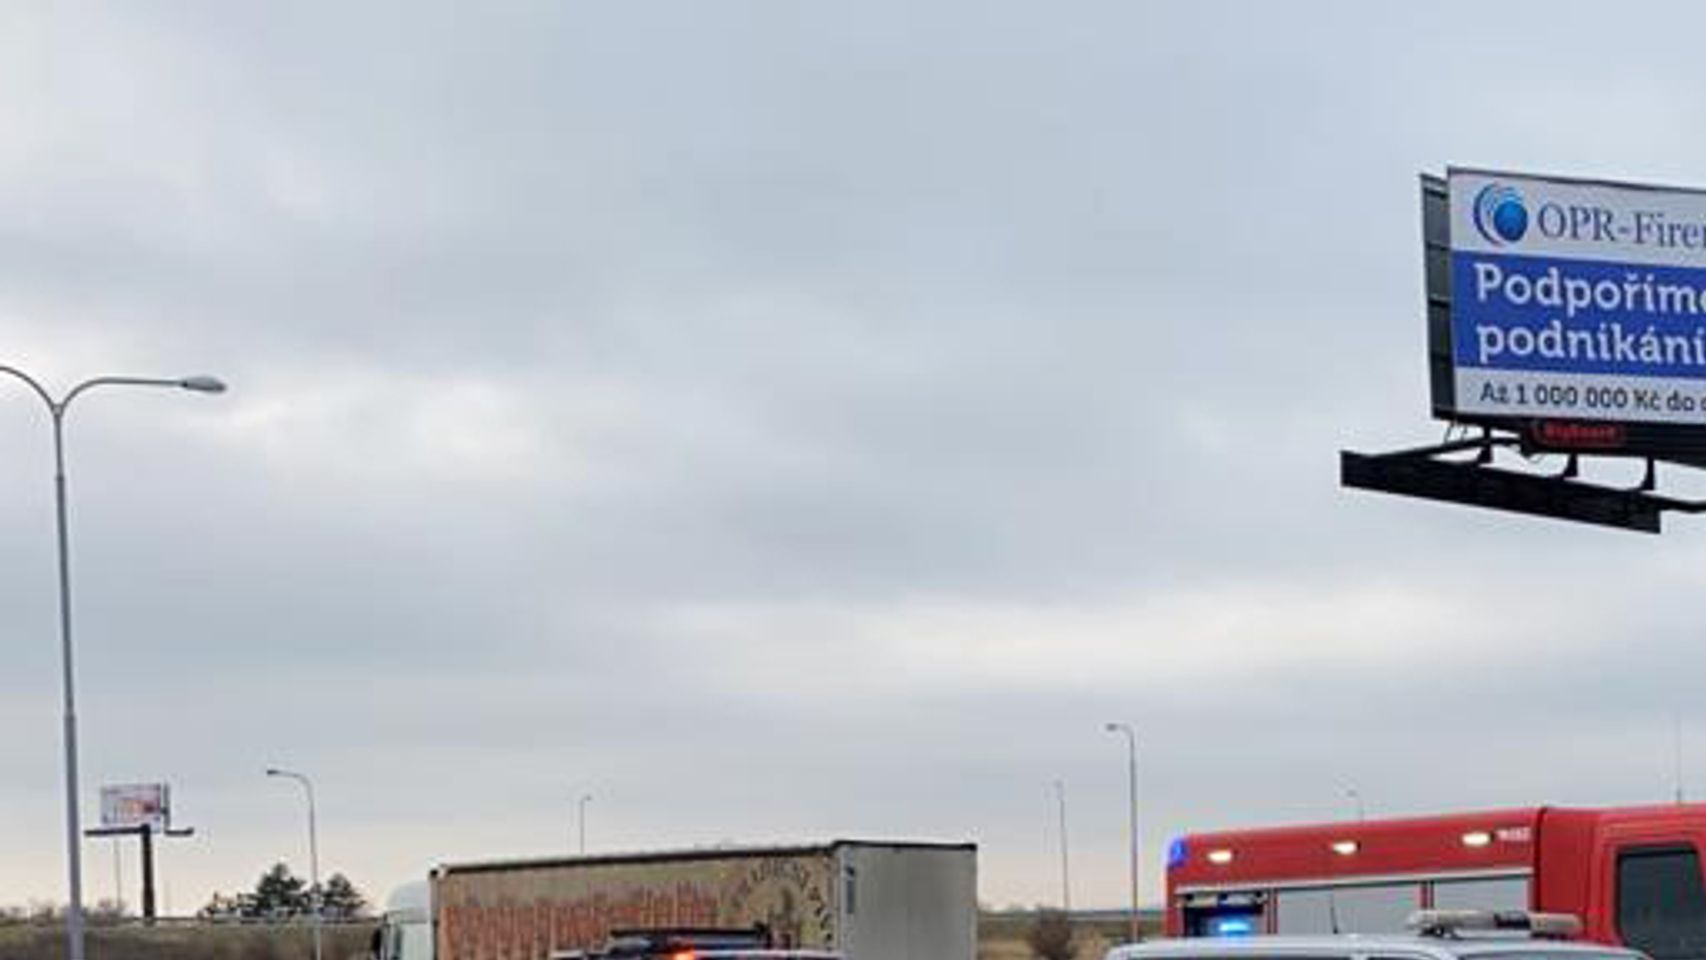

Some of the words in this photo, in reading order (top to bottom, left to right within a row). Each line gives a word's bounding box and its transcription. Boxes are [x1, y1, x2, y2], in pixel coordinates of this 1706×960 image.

[1480, 381, 1508, 404] Až
[1516, 383, 1528, 405] 1
[1534, 385, 1578, 407] 000
[1585, 387, 1629, 409] 000
[1633, 387, 1661, 411] Kč
[1666, 389, 1696, 412] do
